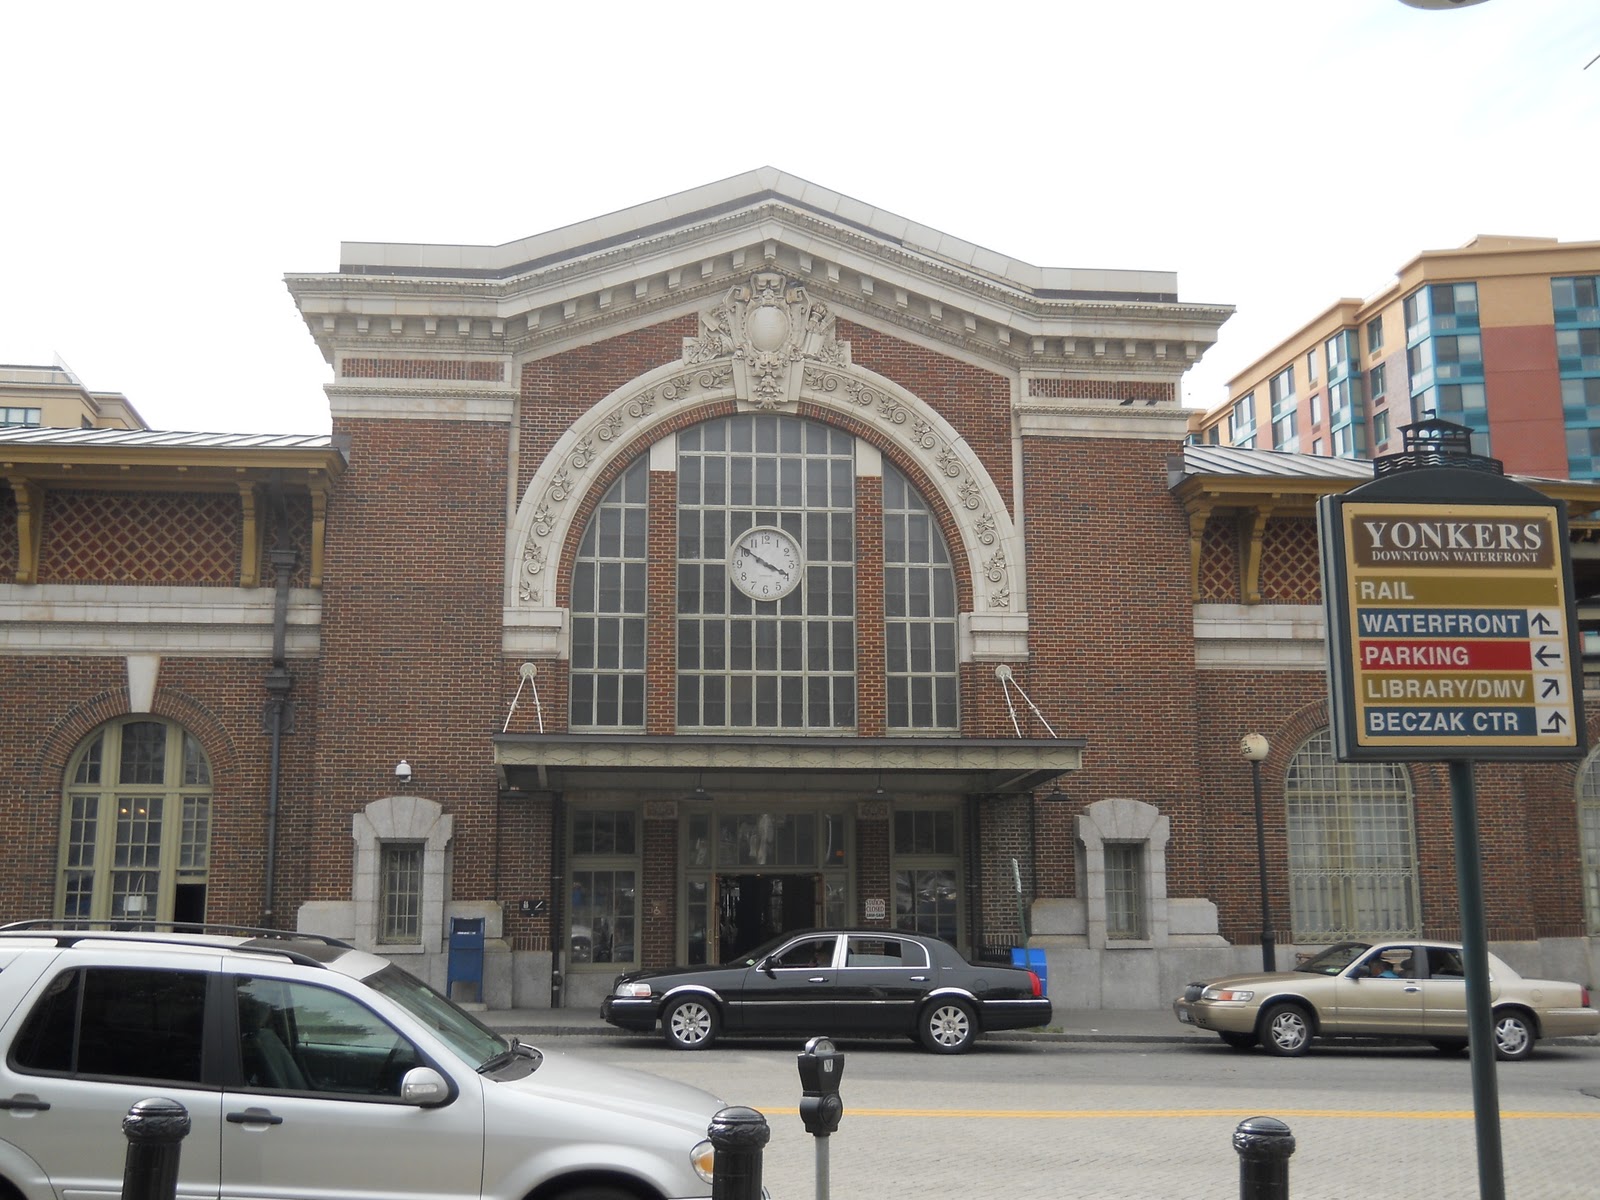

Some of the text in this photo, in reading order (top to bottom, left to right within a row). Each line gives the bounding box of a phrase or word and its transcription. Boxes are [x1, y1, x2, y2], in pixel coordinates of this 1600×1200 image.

[761, 535, 771, 545] 12
[1363, 521, 1542, 551] YONKERS
[750, 539, 758, 548] 11
[740, 548, 750, 558] 10
[783, 547, 790, 557] 2
[1372, 550, 1539, 563] DOWNTOWN WATERFRONT
[736, 560, 743, 569] 9
[788, 560, 795, 569] 3
[740, 572, 747, 581] 8
[783, 572, 790, 581] 4
[751, 581, 757, 590] 7
[762, 585, 769, 594] 6
[775, 582, 782, 591] 5
[1360, 581, 1414, 600] RAIL
[1362, 614, 1521, 634] WATERFRONT
[1365, 646, 1469, 666] PARKING
[1367, 679, 1525, 699] LIBRARY/DMV
[1370, 711, 1519, 731] BECZAK CTR
